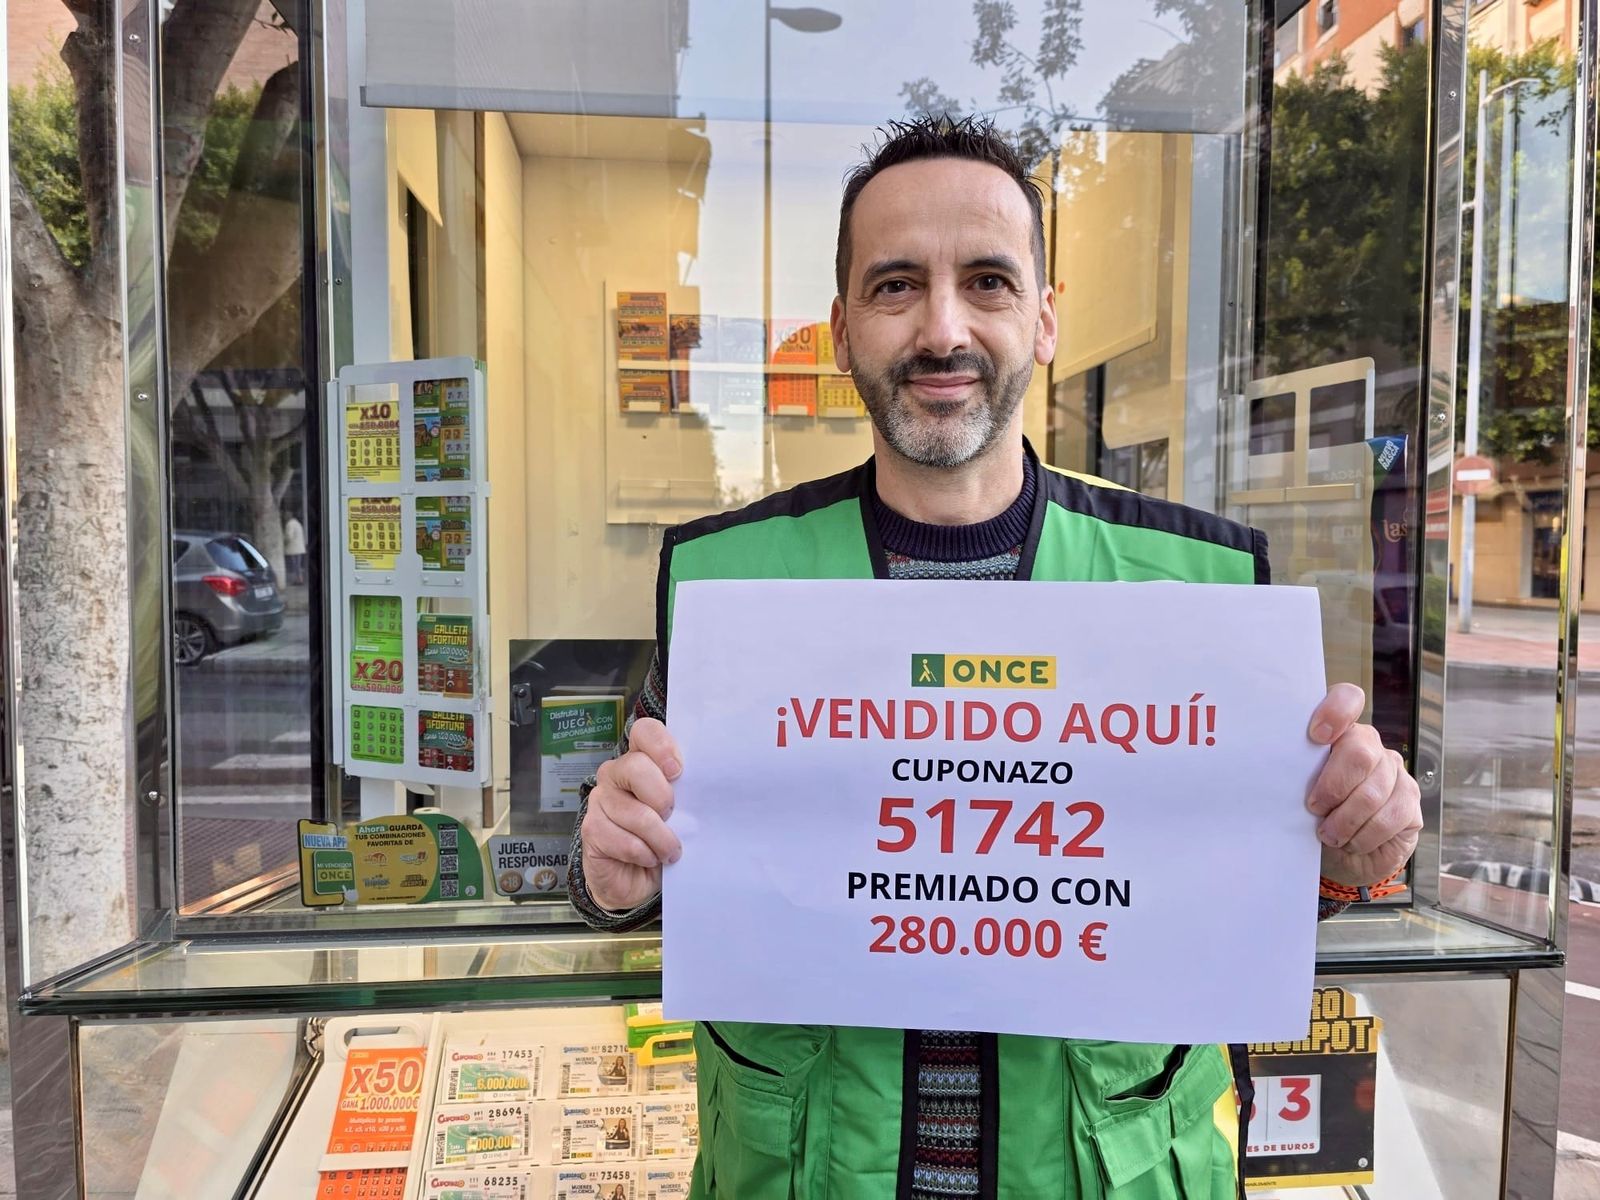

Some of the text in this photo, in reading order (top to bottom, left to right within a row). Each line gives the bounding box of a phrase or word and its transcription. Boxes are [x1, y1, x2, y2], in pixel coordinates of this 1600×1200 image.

[360, 404, 391, 420] x10
[1378, 440, 1394, 464] NUEVO
[1381, 444, 1400, 470] RASCA
[434, 625, 468, 635] GALLETA
[434, 635, 468, 645] FORTUNA
[354, 659, 403, 682] x20
[952, 659, 1049, 684] ONCE
[550, 708, 585, 720] Disfruta y
[596, 715, 613, 724] CON
[431, 720, 465, 731] FORTUNA
[776, 692, 1216, 754] ¡VENDIDO AQUÍ!
[552, 724, 613, 740] RESPONSABILIDAD
[892, 758, 1073, 784] CUPONAZO
[359, 824, 423, 834] Ahora GUARDA
[877, 797, 1105, 858] 51742
[304, 835, 331, 847] NUEVA
[370, 831, 426, 840] COMBINACIONES
[498, 842, 535, 855] JUEGA
[320, 871, 351, 880] ONCE
[848, 872, 1131, 907] PREMIADO CON
[869, 915, 1108, 962] 280.000 €
[502, 1050, 533, 1059] 17453
[348, 1061, 420, 1093] x50
[342, 1096, 420, 1110] GANA 1.000.000€
[488, 1107, 521, 1118] 28694
[605, 1106, 632, 1115] 18924
[1264, 1144, 1277, 1152] DE
[1281, 1143, 1315, 1151] EUROS
[484, 1177, 518, 1186] 68235
[601, 1171, 630, 1180] 73458
